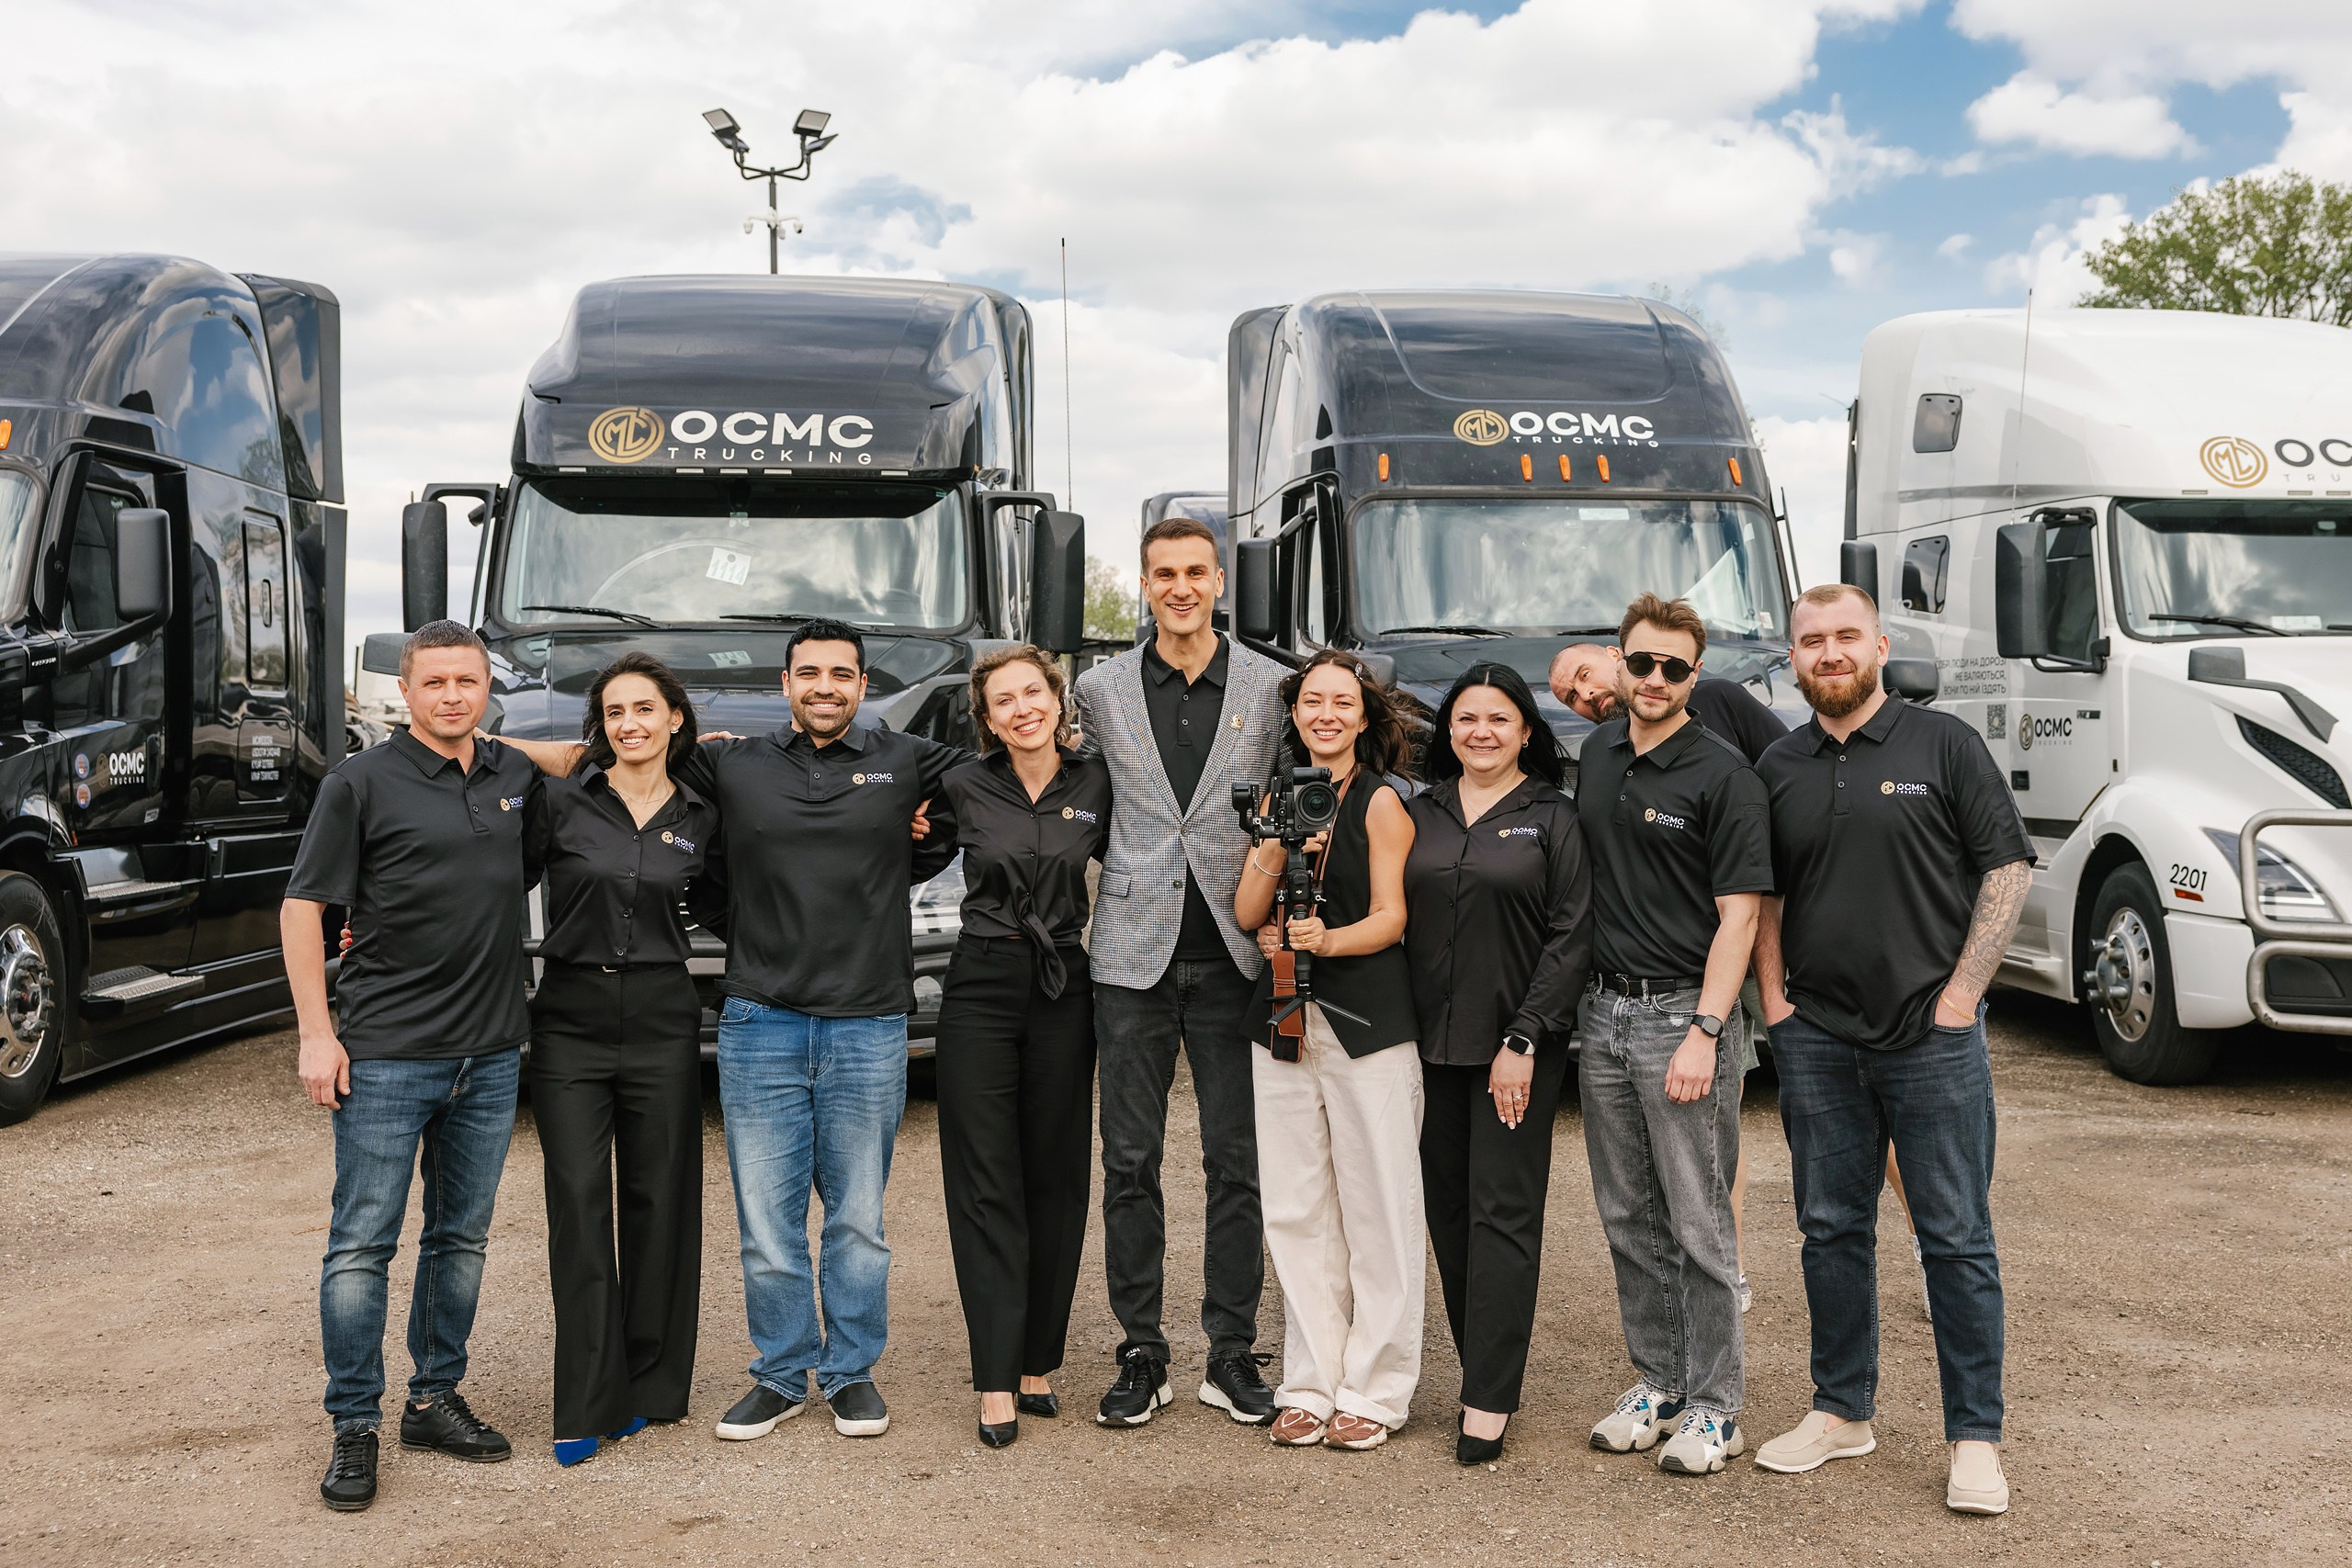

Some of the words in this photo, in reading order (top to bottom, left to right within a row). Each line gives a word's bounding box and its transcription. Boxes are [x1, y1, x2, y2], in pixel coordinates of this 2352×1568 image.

[670, 410, 874, 448] OCMC
[1510, 411, 1654, 440] OCMC
[1512, 436, 1658, 448] TRUCKING
[667, 446, 872, 465] TRUCKING
[2275, 439, 2352, 468] OC
[1970, 658, 1978, 667] НА
[1980, 656, 2007, 667] ДОРОЗІ
[1955, 671, 1962, 681] НЕ
[1943, 685, 1959, 695] ВОНИ
[1960, 684, 1969, 694] ПО
[2034, 717, 2072, 738] OCMC
[109, 752, 144, 775] OCMC
[109, 775, 144, 785] TRUCKING
[1896, 783, 1928, 791] OCMC
[1657, 812, 1685, 825] OCMC
[2169, 863, 2208, 891] 2201
